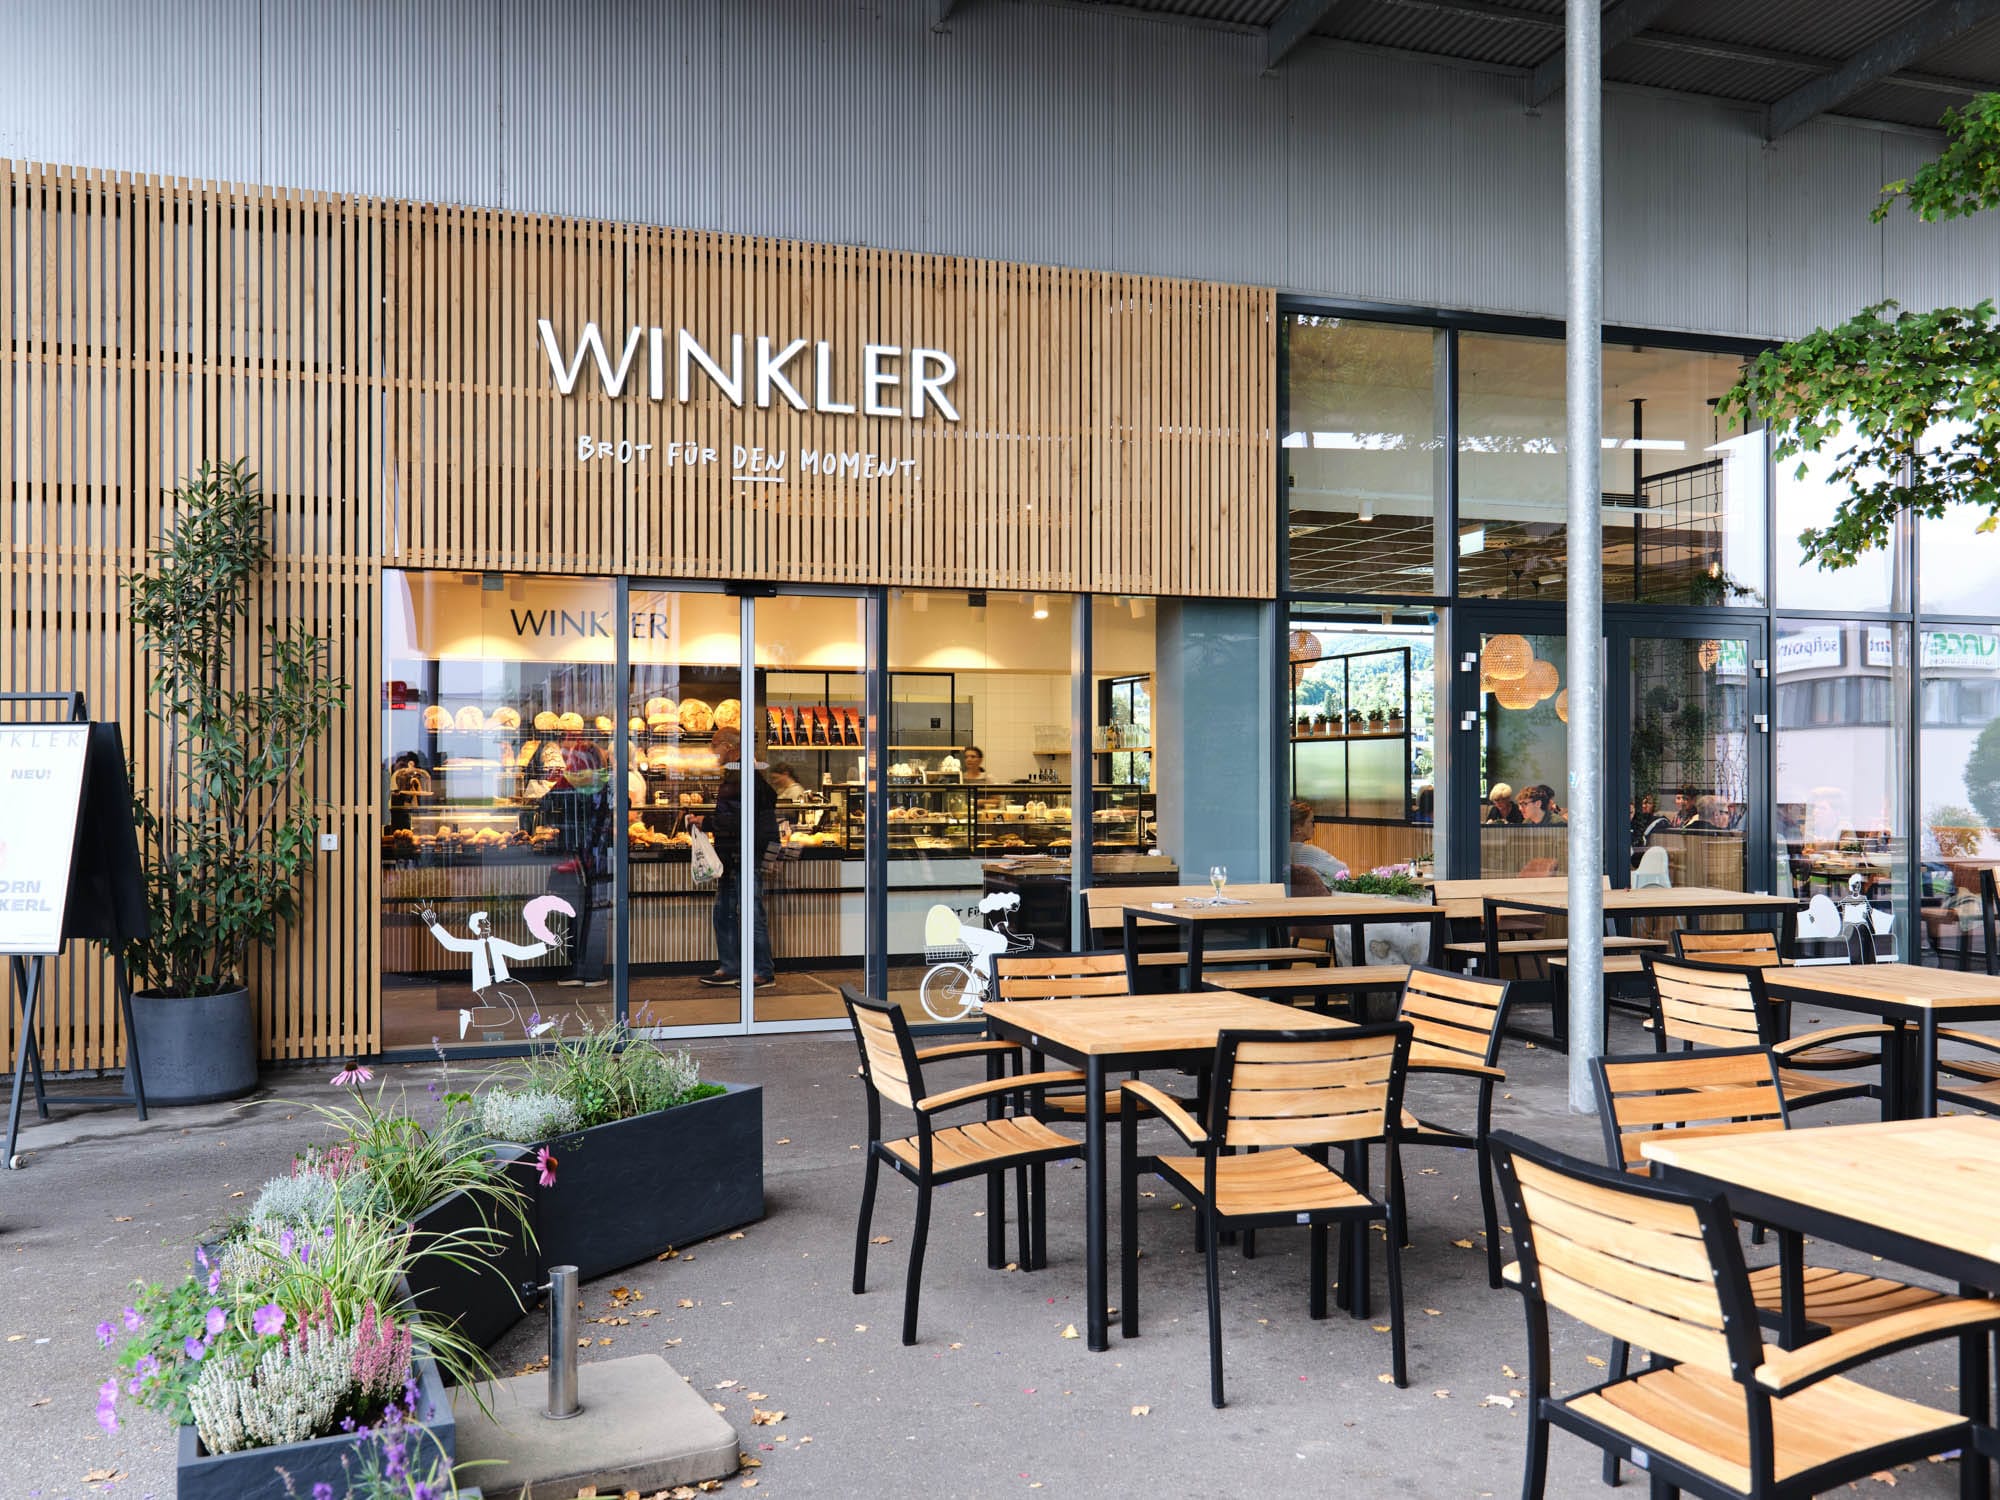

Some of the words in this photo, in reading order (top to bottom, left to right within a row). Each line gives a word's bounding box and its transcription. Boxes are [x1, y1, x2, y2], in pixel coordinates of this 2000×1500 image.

[537, 318, 961, 422] WINKLER
[578, 435, 654, 464] BROT
[667, 441, 718, 467] FÜR
[732, 447, 785, 474] DEN
[510, 608, 669, 640] WINKER
[10, 768, 52, 780] NEU!
